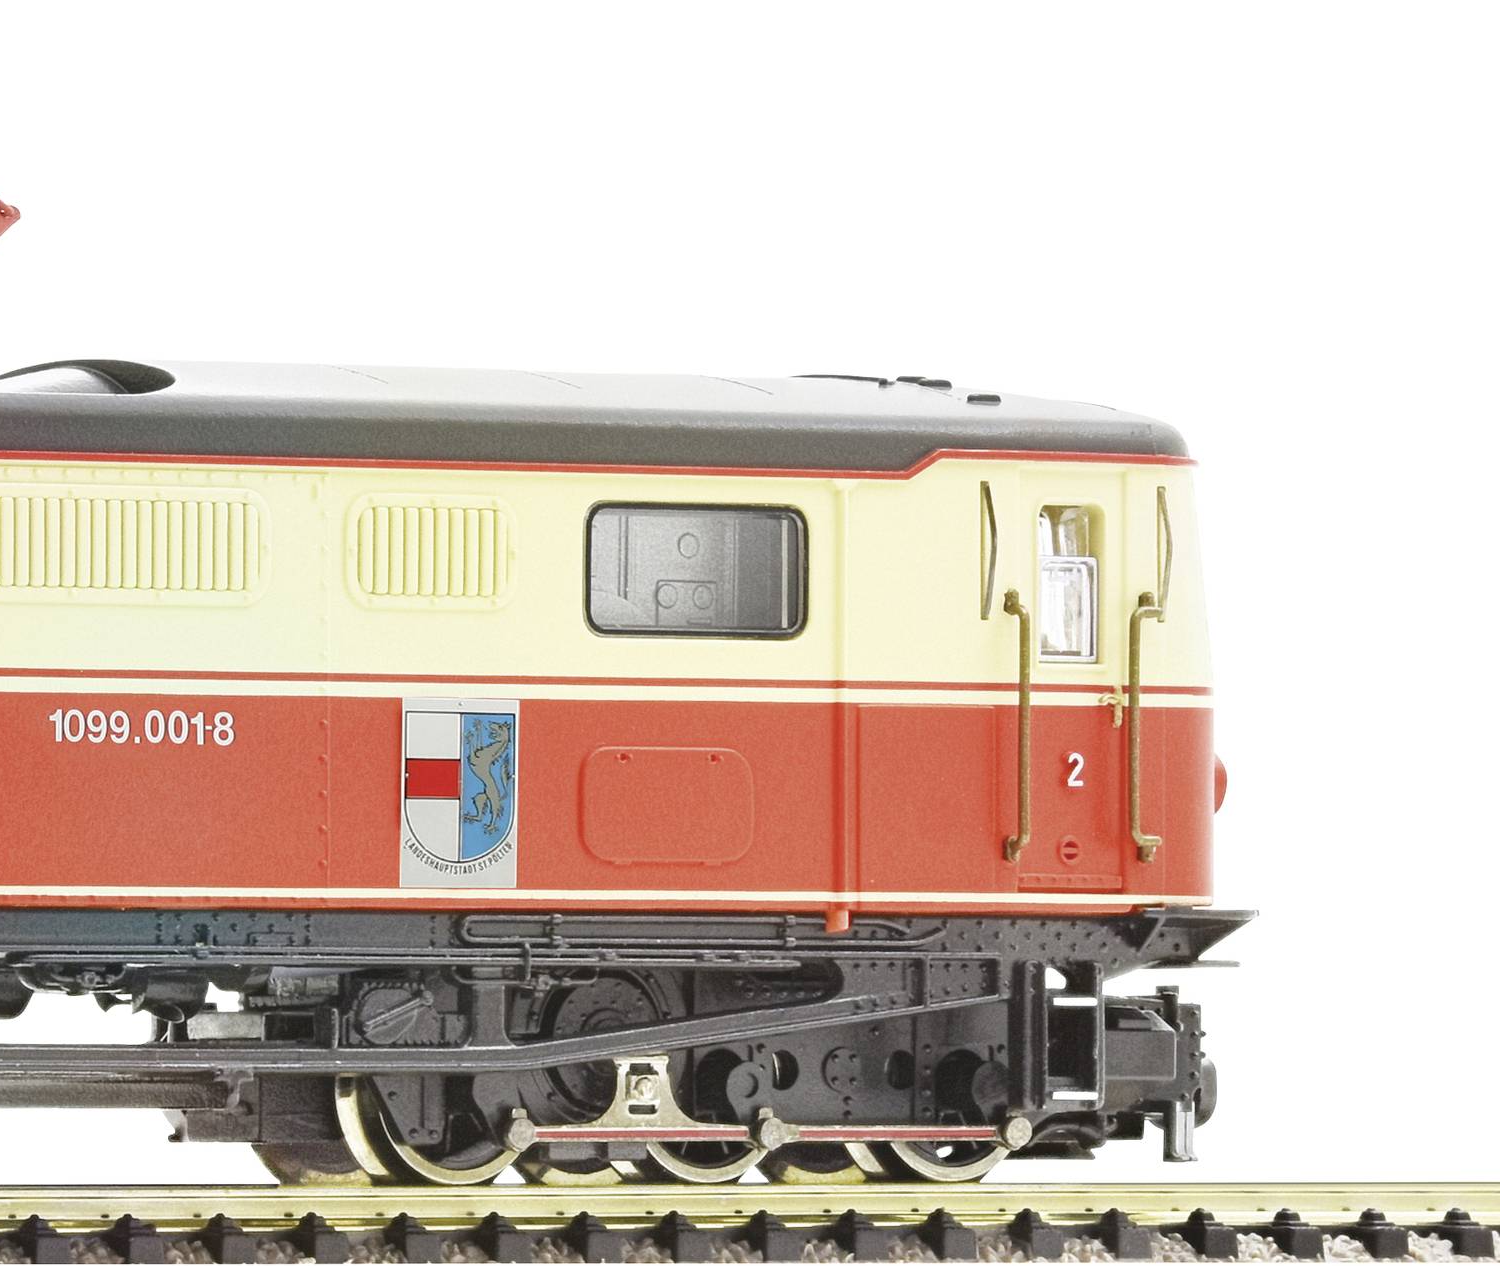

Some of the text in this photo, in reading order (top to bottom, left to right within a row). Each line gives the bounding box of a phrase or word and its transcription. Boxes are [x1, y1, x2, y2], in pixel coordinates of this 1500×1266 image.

[48, 708, 236, 747] 1099.001-8
[1067, 751, 1085, 787] 2
[403, 838, 478, 875] LANDESHAUPTSTADT
